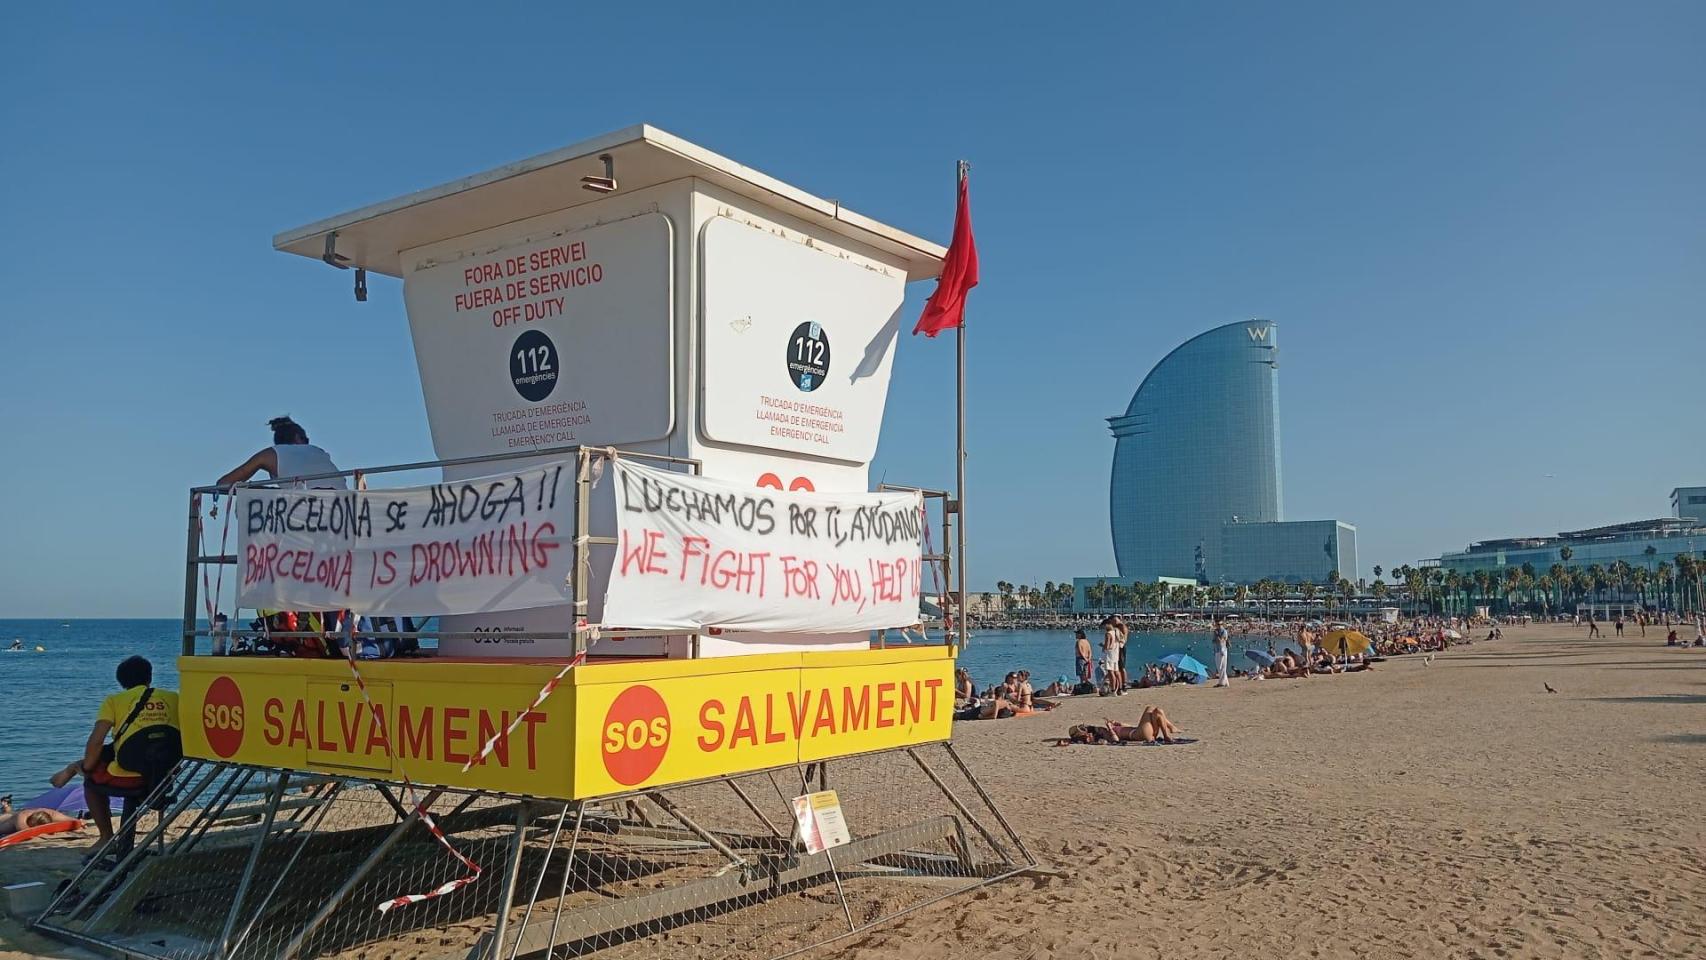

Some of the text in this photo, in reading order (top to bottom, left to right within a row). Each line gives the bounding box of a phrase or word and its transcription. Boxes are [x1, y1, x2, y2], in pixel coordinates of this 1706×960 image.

[464, 241, 587, 287] FORA DE SERVEI
[454, 263, 603, 313] FUERA DE SERVICIO
[492, 296, 565, 328] OFF DUTY
[1247, 327, 1268, 341] W
[517, 345, 552, 374] 112
[796, 336, 825, 365] 112
[493, 409, 527, 422] TRUCADA
[760, 395, 793, 410] TRUCADA
[491, 414, 591, 437] LLAMADA DE EMERGENCIA
[756, 410, 844, 433] LLAMADA DE EMERGENCIA
[770, 426, 830, 444] EMERGENCY CALL
[508, 430, 576, 448] EMERGENCY CALL
[248, 493, 372, 540] BARCELONA
[386, 500, 408, 533] SE
[621, 470, 776, 535] LUCHAMOS
[789, 503, 818, 539] POR
[245, 521, 560, 596] BARCELONA IS DROWNING
[620, 528, 669, 576] WE
[779, 556, 820, 600] FOR
[868, 558, 908, 605] HELP
[604, 678, 944, 754] SOS SALVAMENT
[204, 697, 547, 770] SOS SALVAMENT
